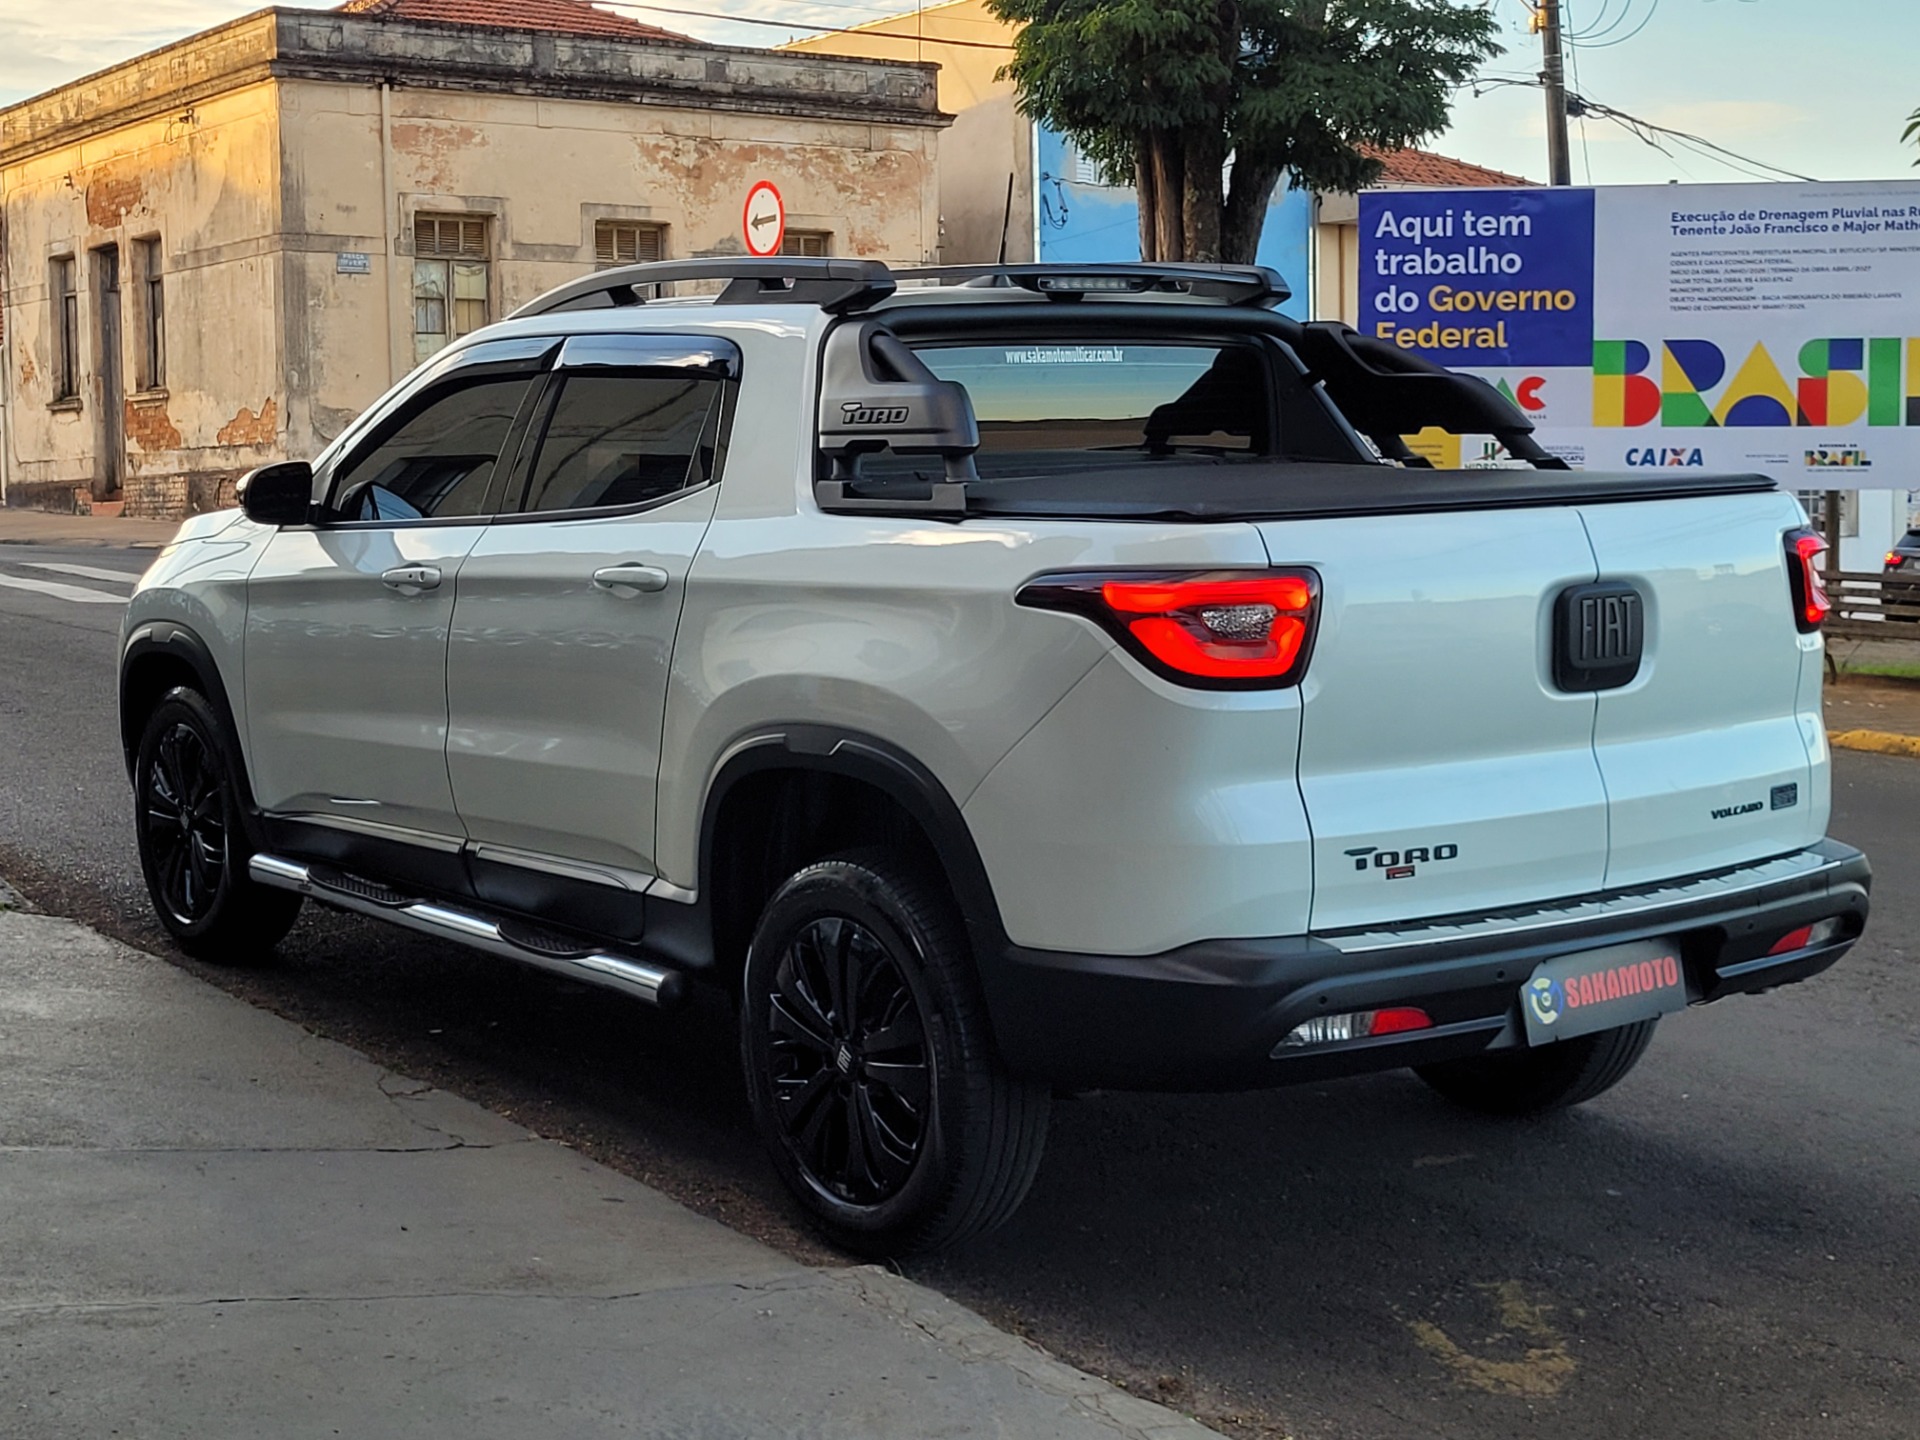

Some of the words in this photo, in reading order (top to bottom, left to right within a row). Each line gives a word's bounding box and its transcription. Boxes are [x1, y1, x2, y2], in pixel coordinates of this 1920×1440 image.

[1374, 209, 1454, 245] Aqui
[1462, 209, 1532, 237] tem
[1670, 224, 1727, 236] Tenente
[1729, 222, 1761, 235] João
[1764, 221, 1829, 234] Francisco
[1832, 223, 1840, 232] e
[1843, 220, 1881, 234] Major
[1884, 219, 1920, 231] Math
[1671, 211, 1735, 224] Execução
[1738, 210, 1756, 221] de
[1759, 208, 1828, 222] Drenagem
[1832, 206, 1879, 219] Pluvial
[1881, 208, 1905, 217] nas
[1375, 246, 1523, 275] trabalho
[1374, 284, 1420, 313] do
[1428, 284, 1577, 312] Governo
[1376, 320, 1509, 349] Federal
[1005, 346, 1124, 364] www.sakamotomulticar.com.br
[1592, 336, 1920, 428] BRASI
[840, 401, 910, 425] TORO
[1625, 447, 1704, 467] CAIXA
[1804, 449, 1873, 467] BRASIL
[1581, 595, 1636, 660] FIAT
[1343, 843, 1458, 871] TORO
[1564, 955, 1679, 1008] SAKAMOTO
